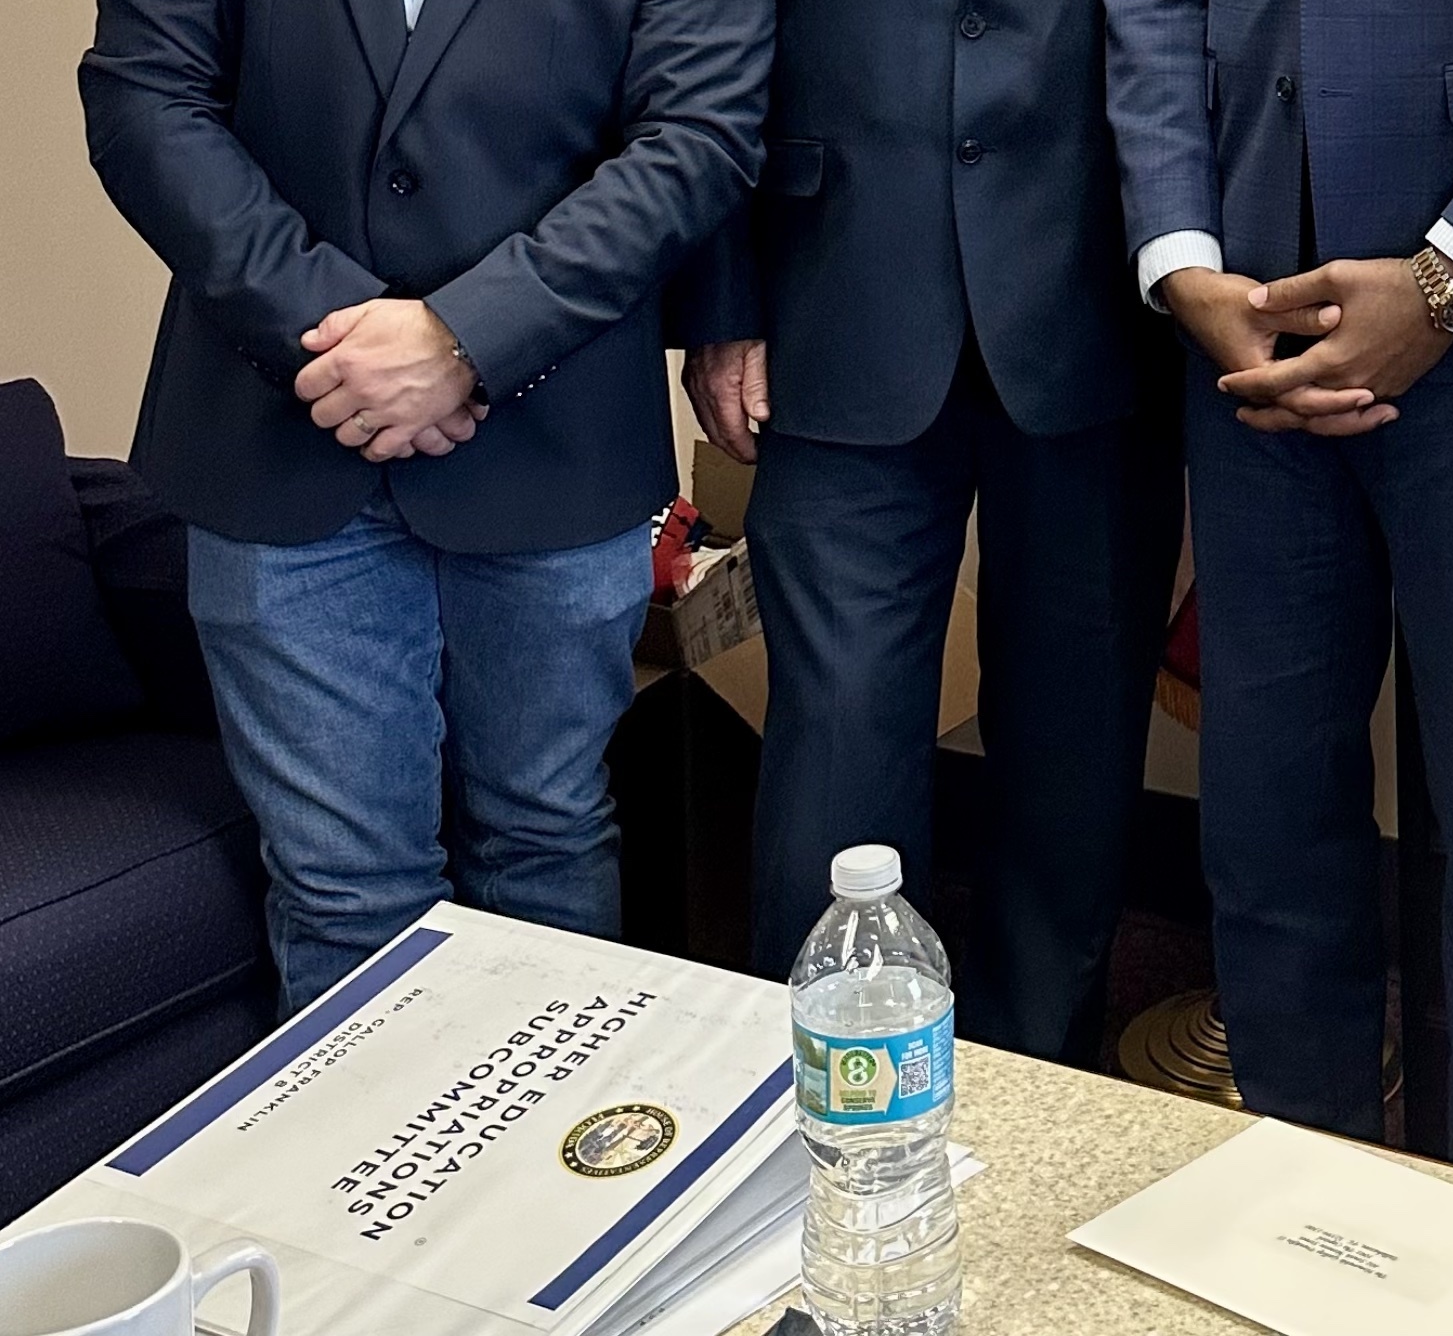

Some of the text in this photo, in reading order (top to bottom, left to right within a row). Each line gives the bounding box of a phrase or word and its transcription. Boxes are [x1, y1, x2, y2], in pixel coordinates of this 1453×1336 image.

[237, 988, 424, 1132] REP. GALLOP FRANKLIN
[274, 1022, 364, 1088] DISTRICT 8
[331, 999, 570, 1194] SUBCOMMITTEE
[347, 995, 609, 1216] APPROPRIATIONS
[359, 991, 659, 1241] HIGHER EDUCATION
